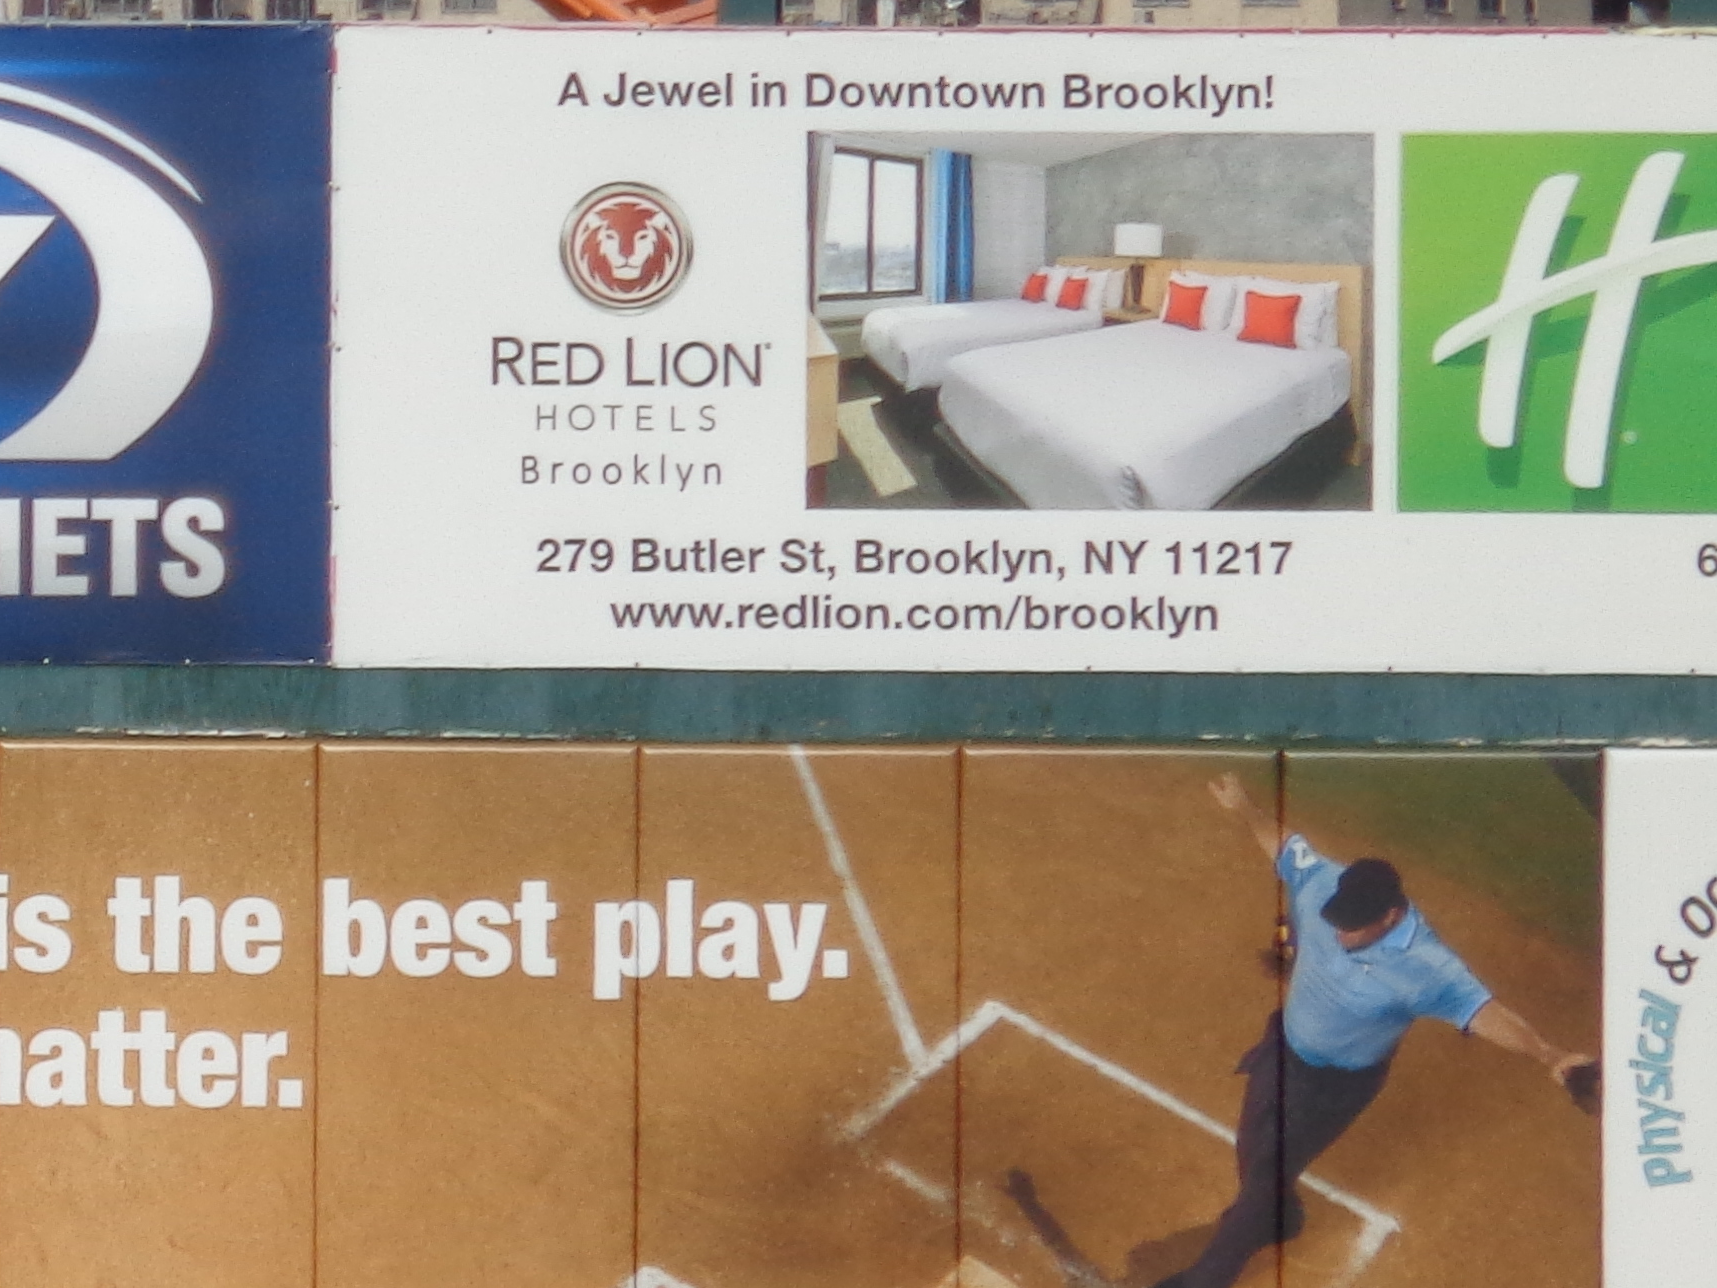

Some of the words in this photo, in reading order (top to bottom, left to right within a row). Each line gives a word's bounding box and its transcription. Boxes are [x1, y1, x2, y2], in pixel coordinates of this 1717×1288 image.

[557, 72, 589, 107] A
[603, 72, 734, 108] Jewel
[750, 72, 787, 107] in
[805, 73, 1045, 109] Downtown
[1063, 73, 1274, 117] Brooklyn!
[491, 336, 606, 386] RED
[625, 336, 762, 388] LION
[535, 403, 716, 432] HOTELS
[521, 453, 722, 493] Brooklyn
[535, 538, 615, 574] 279
[630, 538, 765, 576] Butler
[779, 538, 836, 580] St,
[853, 539, 1066, 583] Brooklyn,
[1083, 540, 1147, 576] NY
[1165, 540, 1293, 576] 11217
[608, 593, 1220, 641] www.redlion.com/brooklyn
[107, 874, 284, 977] the
[322, 876, 558, 979] best
[591, 877, 850, 1001] play.
[1654, 943, 1700, 986] &
[1628, 988, 1693, 1188] physical
